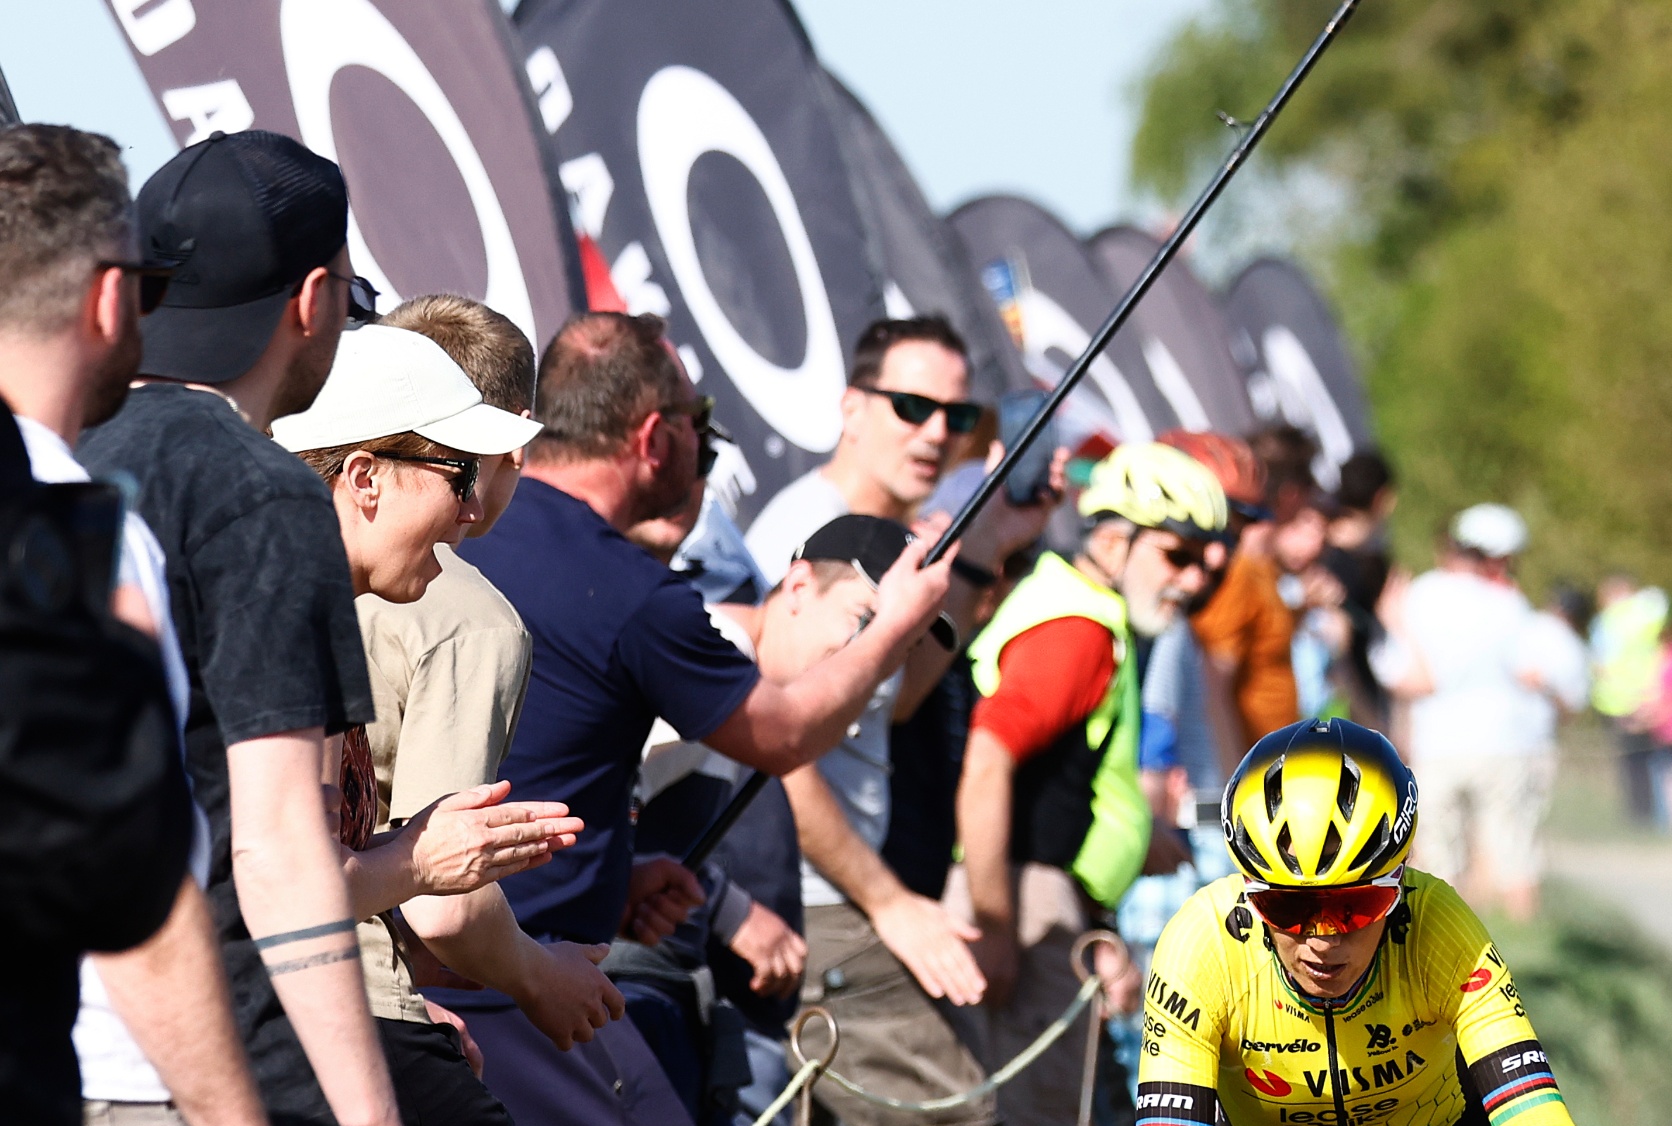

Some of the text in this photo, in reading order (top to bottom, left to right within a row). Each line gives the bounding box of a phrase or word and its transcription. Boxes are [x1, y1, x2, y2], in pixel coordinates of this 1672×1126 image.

[1393, 780, 1418, 844] GIRO
[1147, 968, 1202, 1032] VISMA
[1285, 1003, 1311, 1024] VISMA
[1241, 1038, 1322, 1054] cervélo
[1303, 1049, 1427, 1099] VISMA
[1136, 1093, 1194, 1111] RAM
[1280, 1097, 1400, 1123] lease
